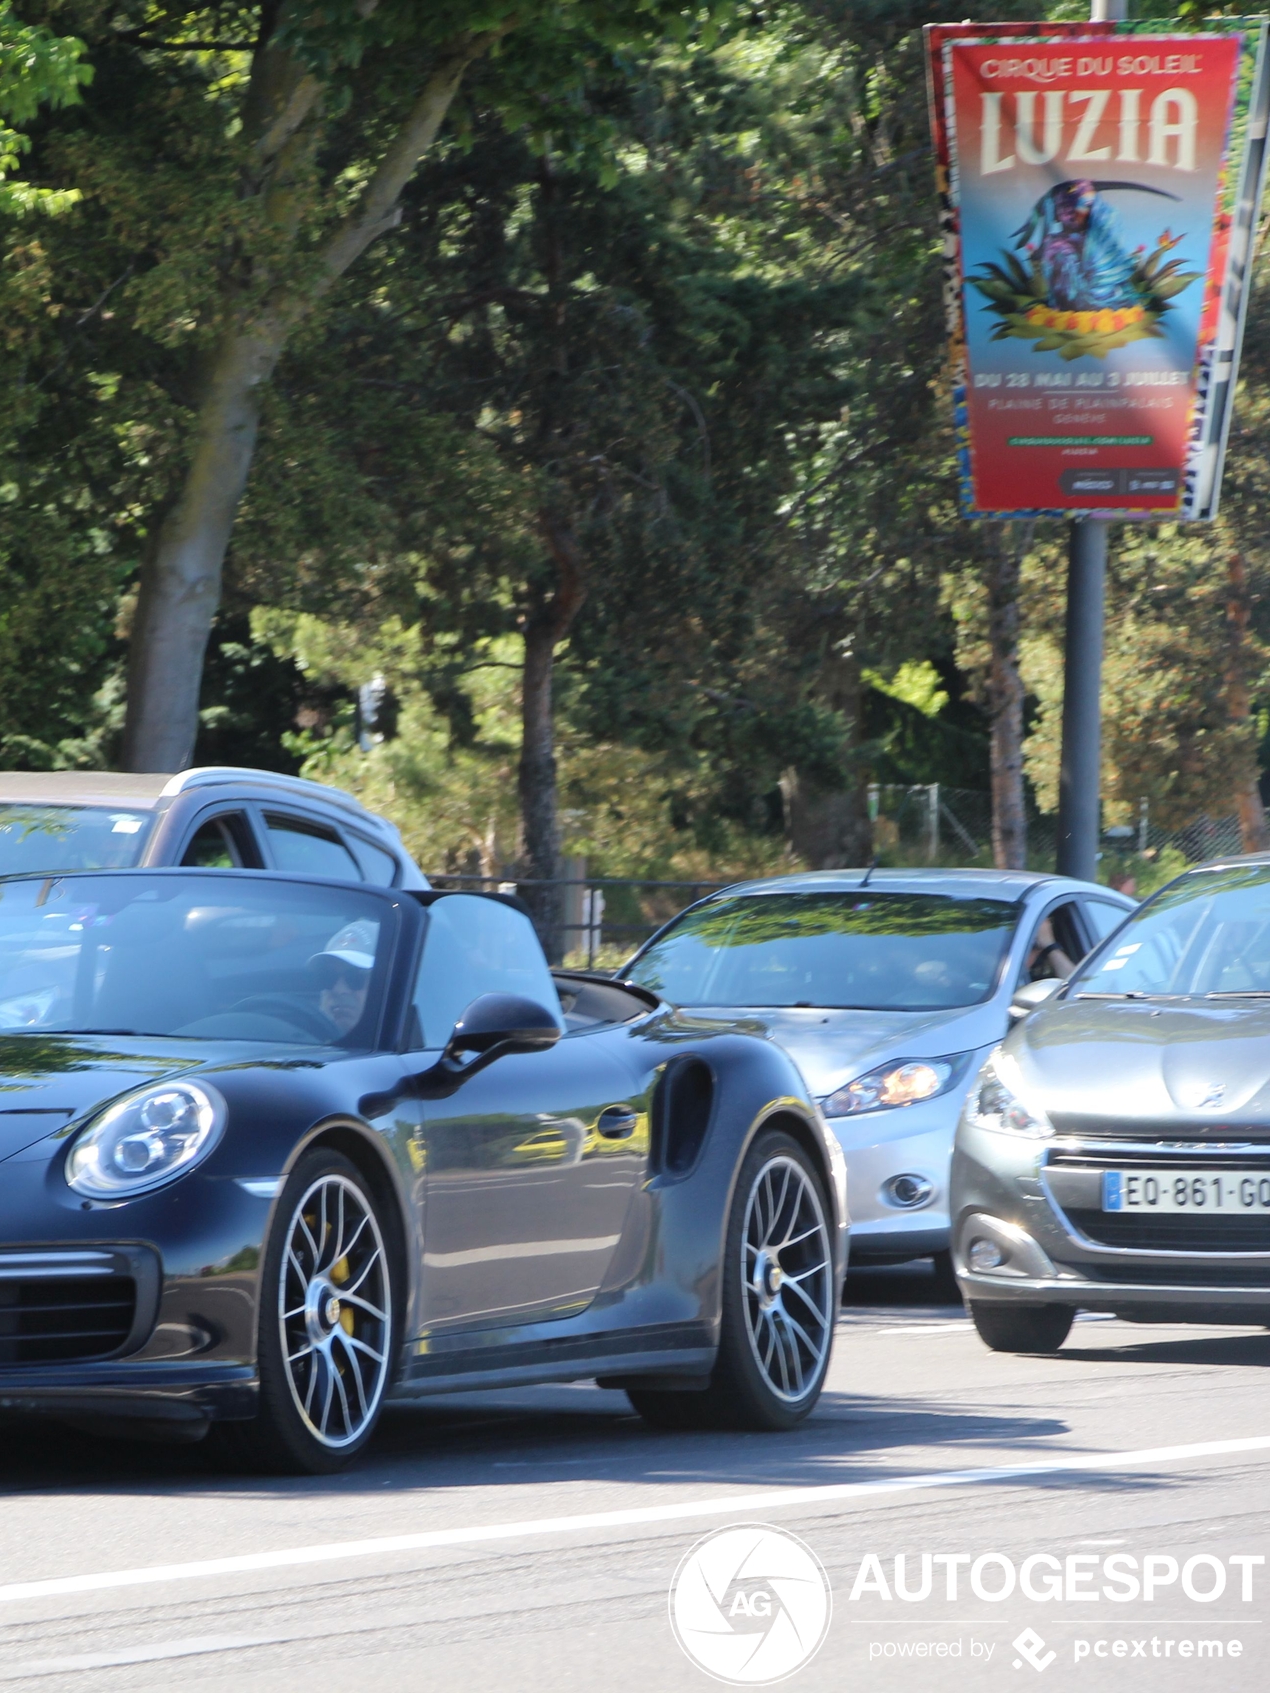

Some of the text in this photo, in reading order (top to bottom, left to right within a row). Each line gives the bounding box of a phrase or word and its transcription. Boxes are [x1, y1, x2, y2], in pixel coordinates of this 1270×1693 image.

[980, 54, 1203, 83] CIRQUE DU SOLEIL
[979, 87, 1199, 176] LUZIA
[974, 373, 1002, 388] DU
[1034, 372, 1072, 387] MAI
[1075, 371, 1104, 387] AU
